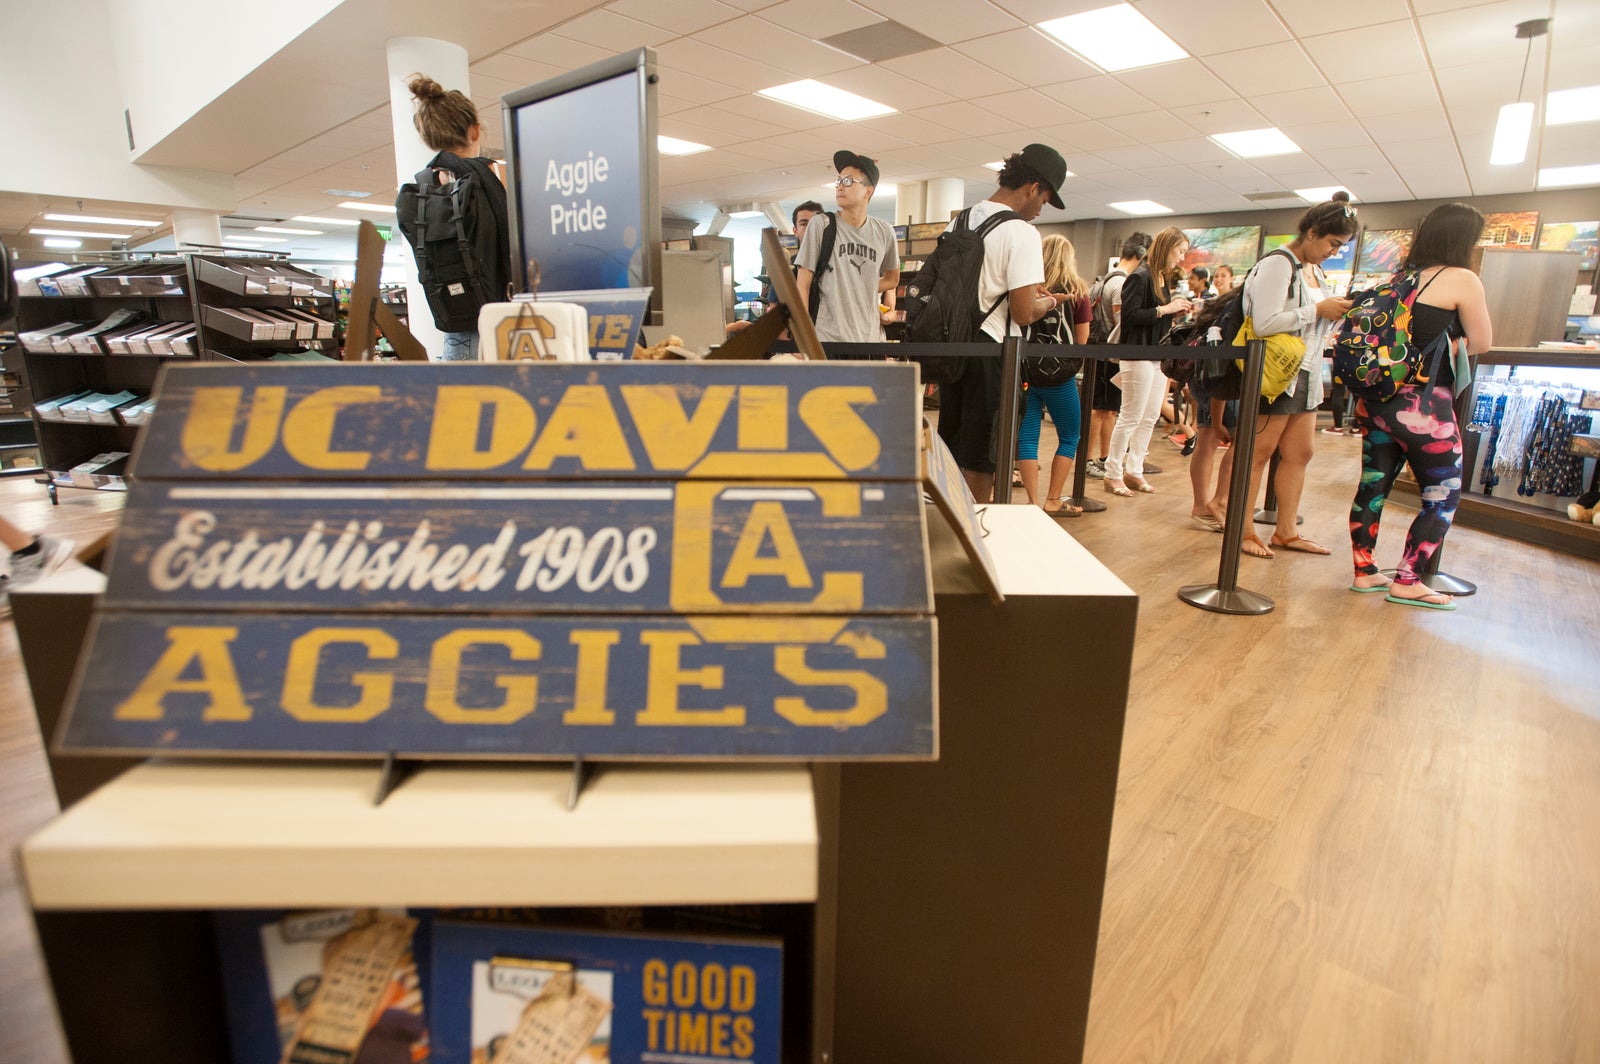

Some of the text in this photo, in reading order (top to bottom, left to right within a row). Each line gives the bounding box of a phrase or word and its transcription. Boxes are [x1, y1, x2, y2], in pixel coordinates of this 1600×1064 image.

[545, 151, 609, 196] Aggie
[550, 199, 607, 235] Pride
[839, 243, 877, 263] PUMA
[181, 385, 882, 472] UC DAVIS
[149, 510, 658, 592] Established 1908
[113, 626, 888, 727] AGGIES
[642, 958, 757, 1012] GOOD
[641, 1007, 756, 1059] TIMES
